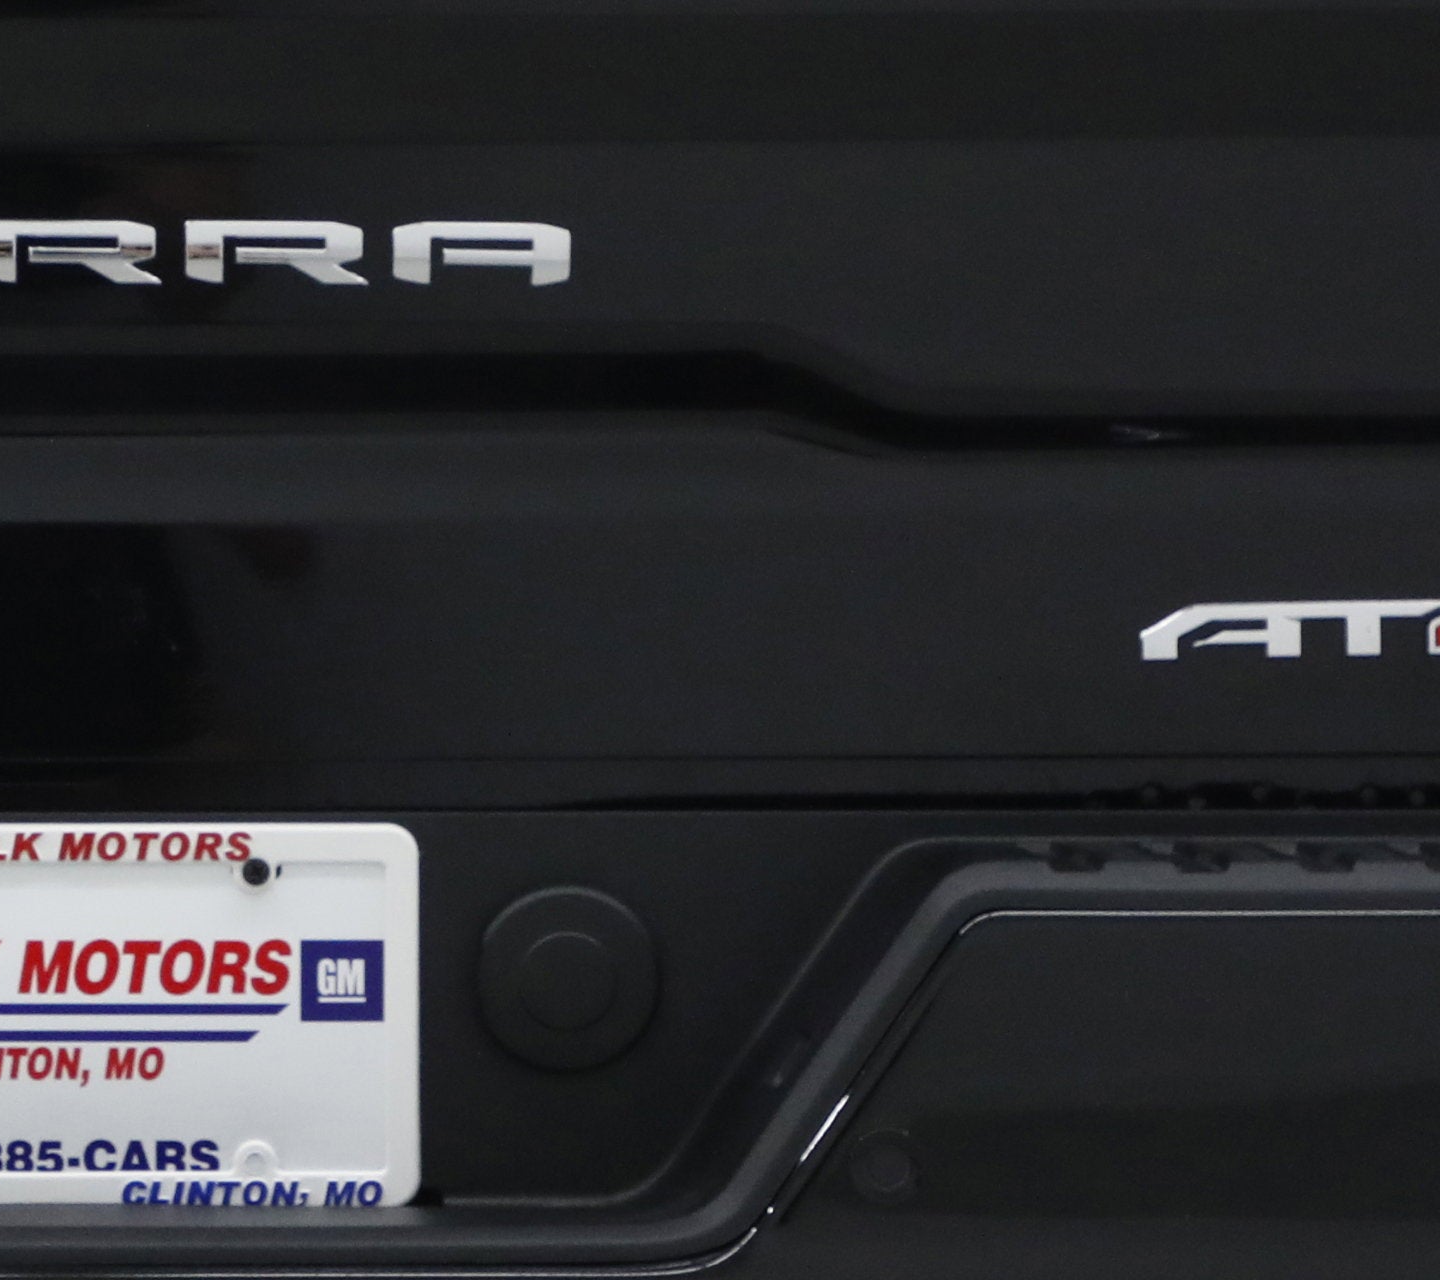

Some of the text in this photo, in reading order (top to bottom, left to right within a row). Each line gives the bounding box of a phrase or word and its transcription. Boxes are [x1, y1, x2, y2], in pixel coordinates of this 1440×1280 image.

[58, 831, 252, 862] MOTORS
[18, 938, 292, 995] MOTORS
[317, 956, 366, 998] GM
[104, 1047, 165, 1081] MO
[323, 1180, 383, 1207] MO
